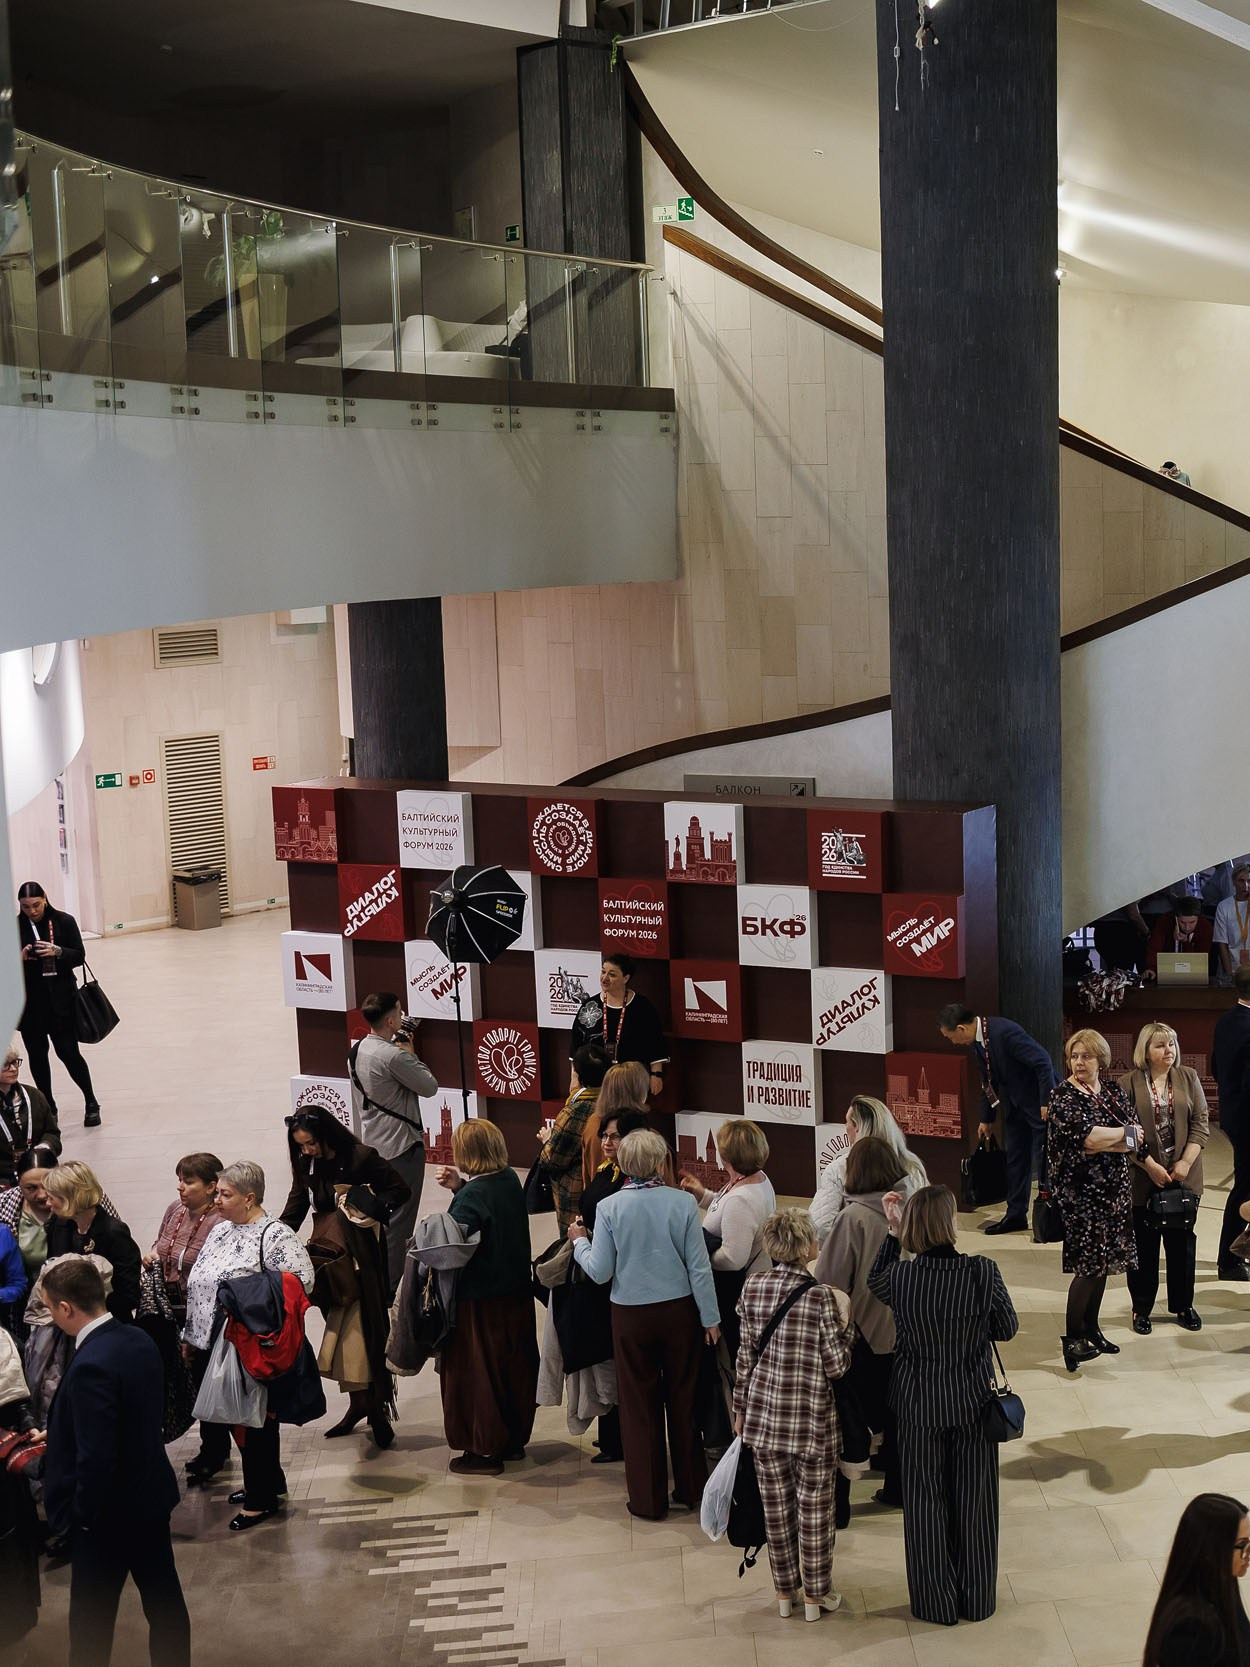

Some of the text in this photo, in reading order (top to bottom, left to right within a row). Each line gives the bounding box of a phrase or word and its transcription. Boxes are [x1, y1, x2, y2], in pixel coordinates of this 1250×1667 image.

[715, 784, 761, 796] БАЛКОН
[401, 812, 460, 824] БАЛТИЙСКИЙ
[402, 826, 458, 838] КУЛЬТУРНЫЙ
[532, 803, 594, 873] СМЫСЛ РОЖДАЕТСЯ В ДИАЛОГЕ
[821, 836, 837, 849] 20
[402, 841, 454, 852] ФОРУМ 2026
[539, 825, 562, 864] МЫСЛЬ
[566, 844, 585, 864] МИР
[821, 849, 837, 861] 26
[345, 869, 396, 921] ДИАЛОГ
[603, 899, 664, 912] БАЛТИЙСКИЙ
[344, 886, 400, 937] КУЛЬТУР
[603, 914, 663, 926] КУЛЬТУРНЫЙ
[603, 928, 658, 940] ФОРУМ 2026
[741, 916, 807, 938] БКФ
[886, 917, 918, 942] МЫСЛЬ
[896, 915, 935, 948] СОЗДАЁТ
[910, 917, 955, 957] МИР
[410, 965, 436, 986] МЫСЛЬ
[418, 963, 450, 992] СОЗДАЁТ
[431, 965, 467, 1001] МИР
[549, 976, 563, 988] 20
[550, 988, 563, 1000] 26
[819, 976, 878, 1029] ДИАЛОГ
[815, 994, 881, 1046] КУЛЬТУР
[477, 1027, 537, 1095] ИСКУССТВО ГОВОРИТ ГРОМЧЕ СЛОВ
[746, 1060, 802, 1083] ТРАДИЦИЯ
[340, 1100, 346, 1108] В
[747, 1085, 811, 1107] И РАЗВИТИЕ
[826, 1133, 849, 1155] ГОВО
